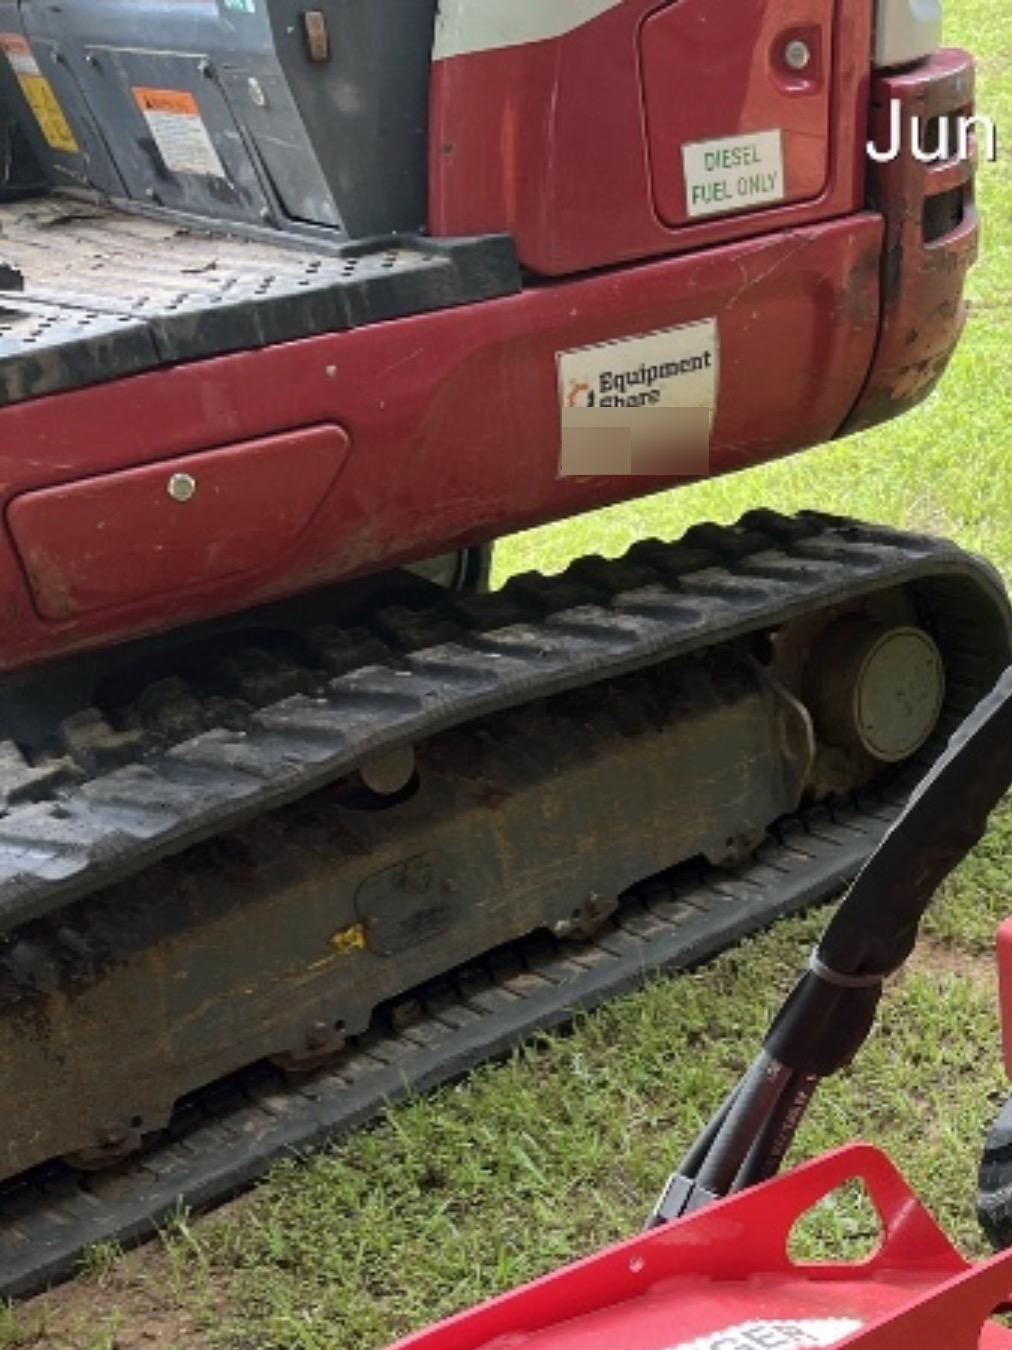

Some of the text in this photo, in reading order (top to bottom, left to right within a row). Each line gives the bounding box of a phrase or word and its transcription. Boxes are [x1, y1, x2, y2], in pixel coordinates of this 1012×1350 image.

[703, 144, 762, 173] DIESEL
[691, 170, 778, 206] FUEL ONLY
[598, 350, 713, 394] Equipment
